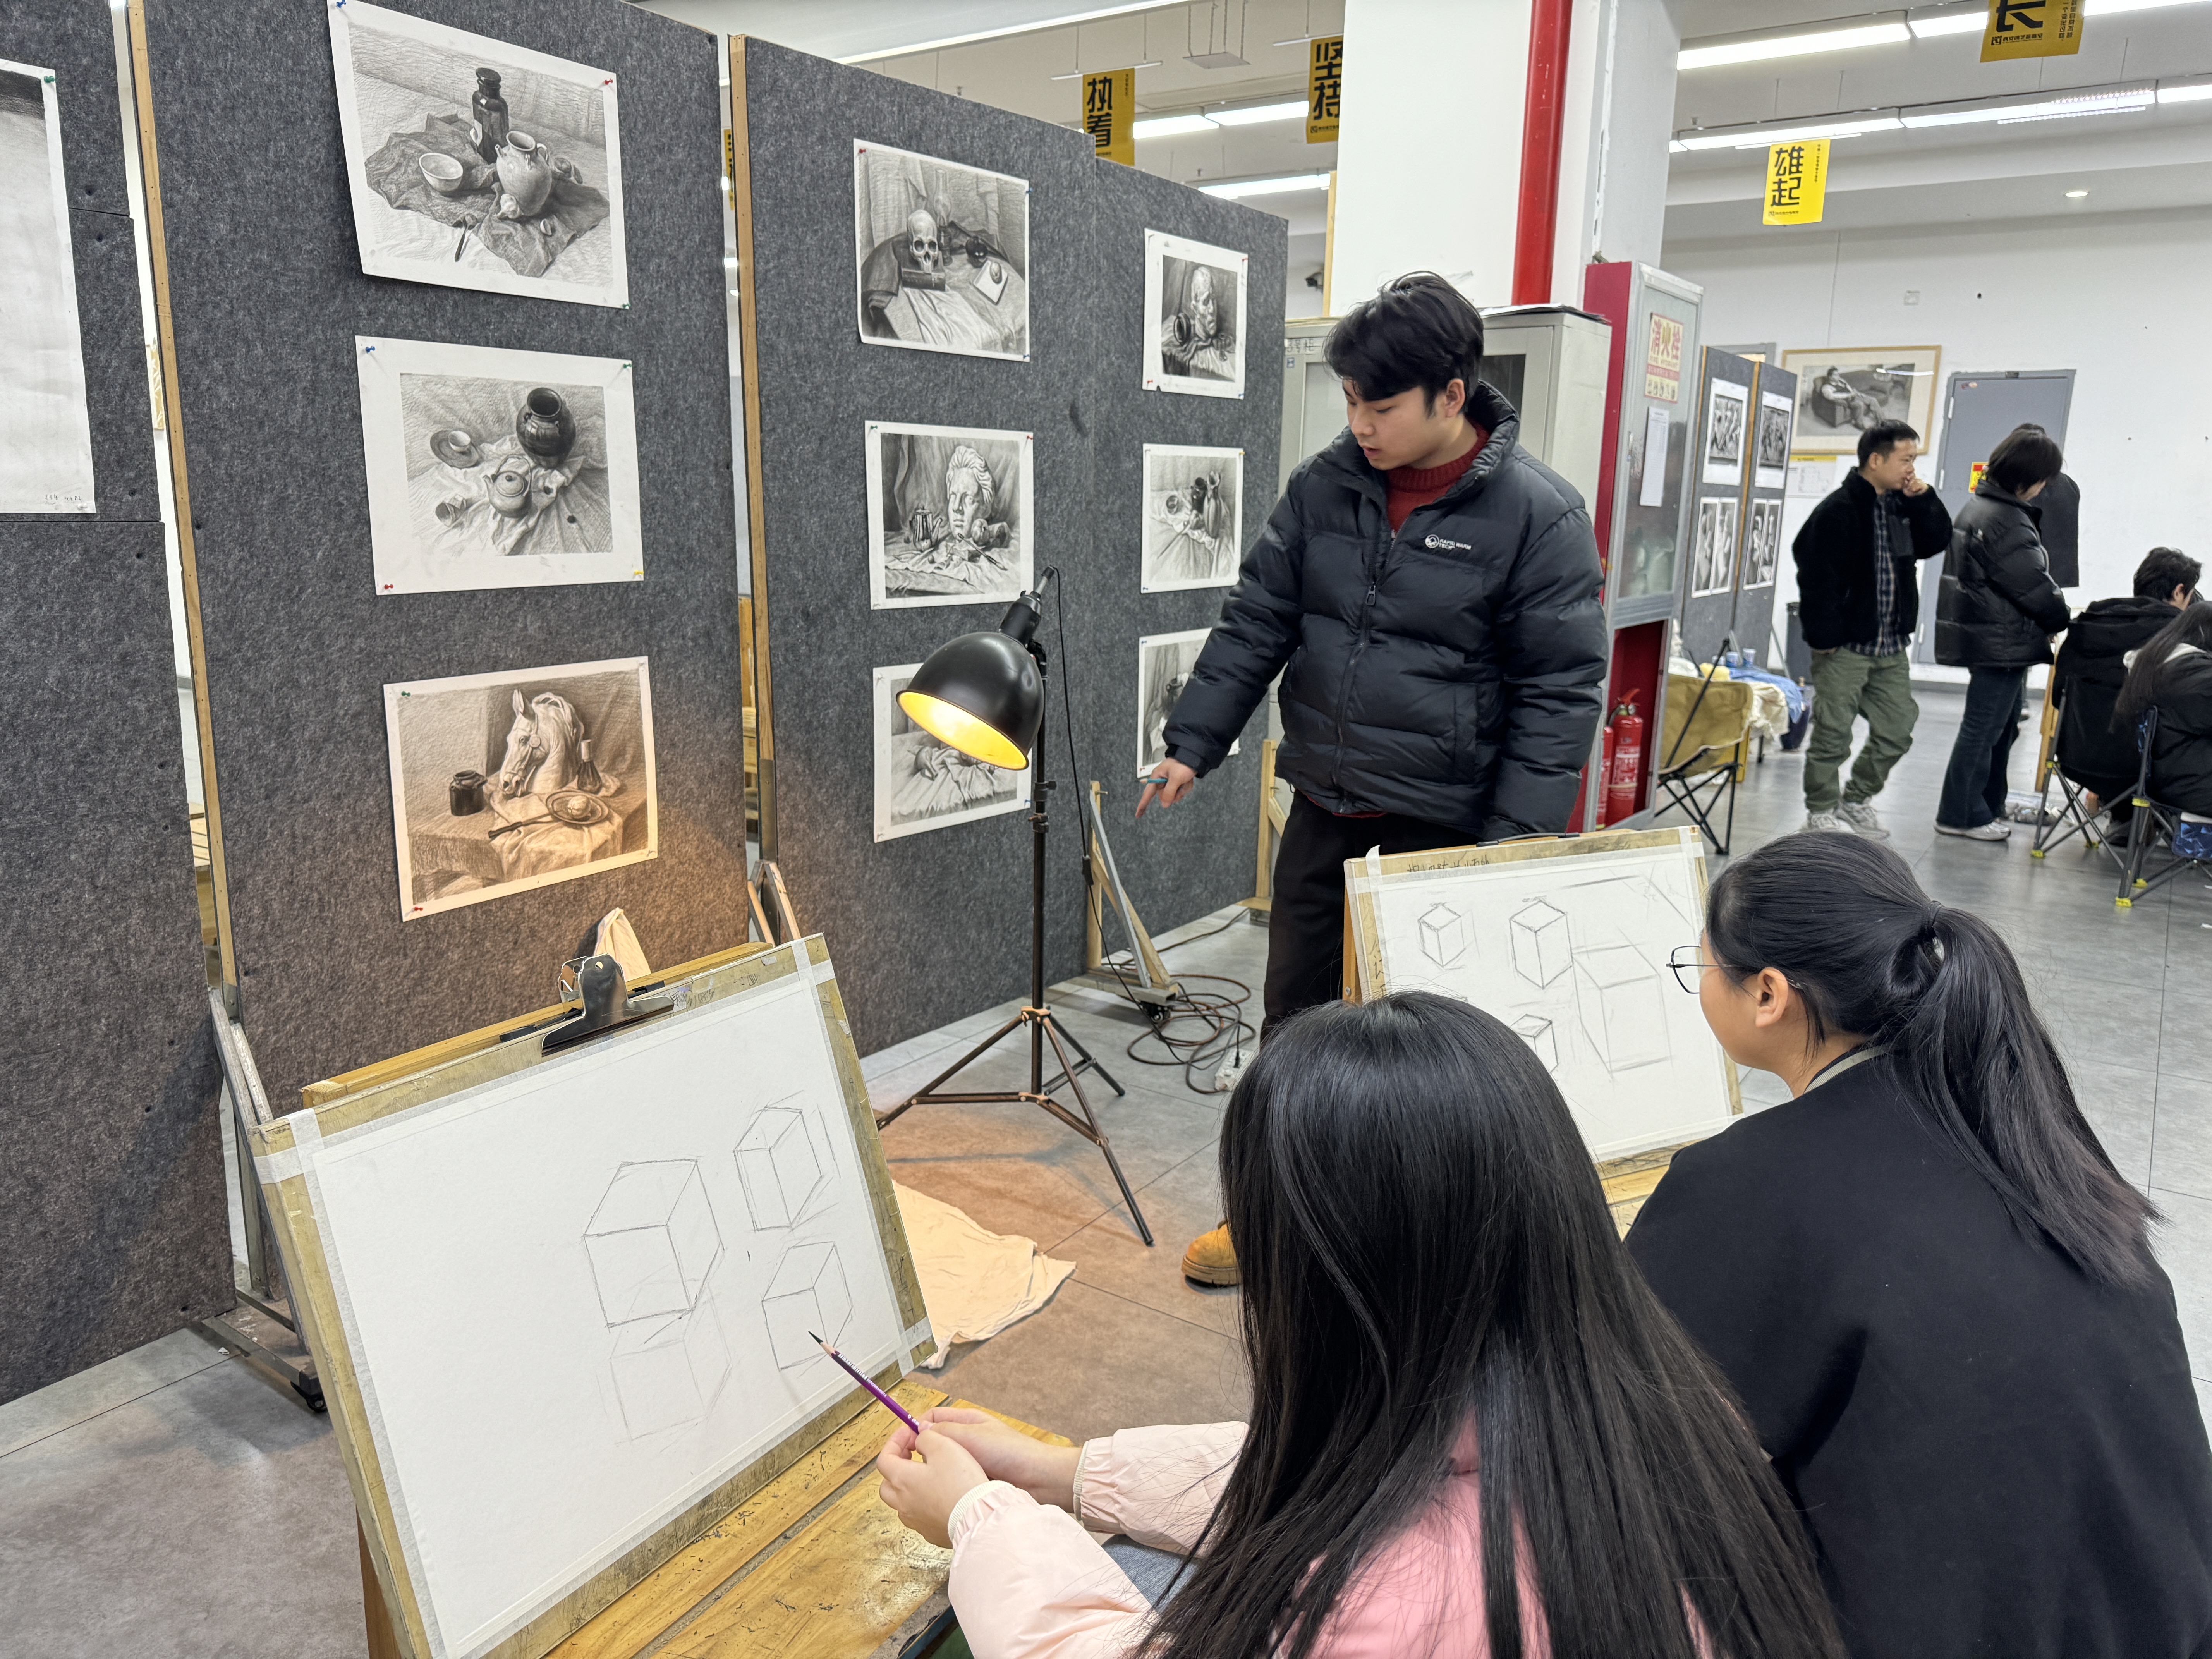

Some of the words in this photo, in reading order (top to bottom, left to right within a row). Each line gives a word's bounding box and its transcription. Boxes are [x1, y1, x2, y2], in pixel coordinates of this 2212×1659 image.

[1087, 76, 1113, 148] 执着
[1314, 41, 1343, 120] 坚持
[1770, 146, 1805, 207] 雄起
[1651, 319, 1680, 360] 消火栓
